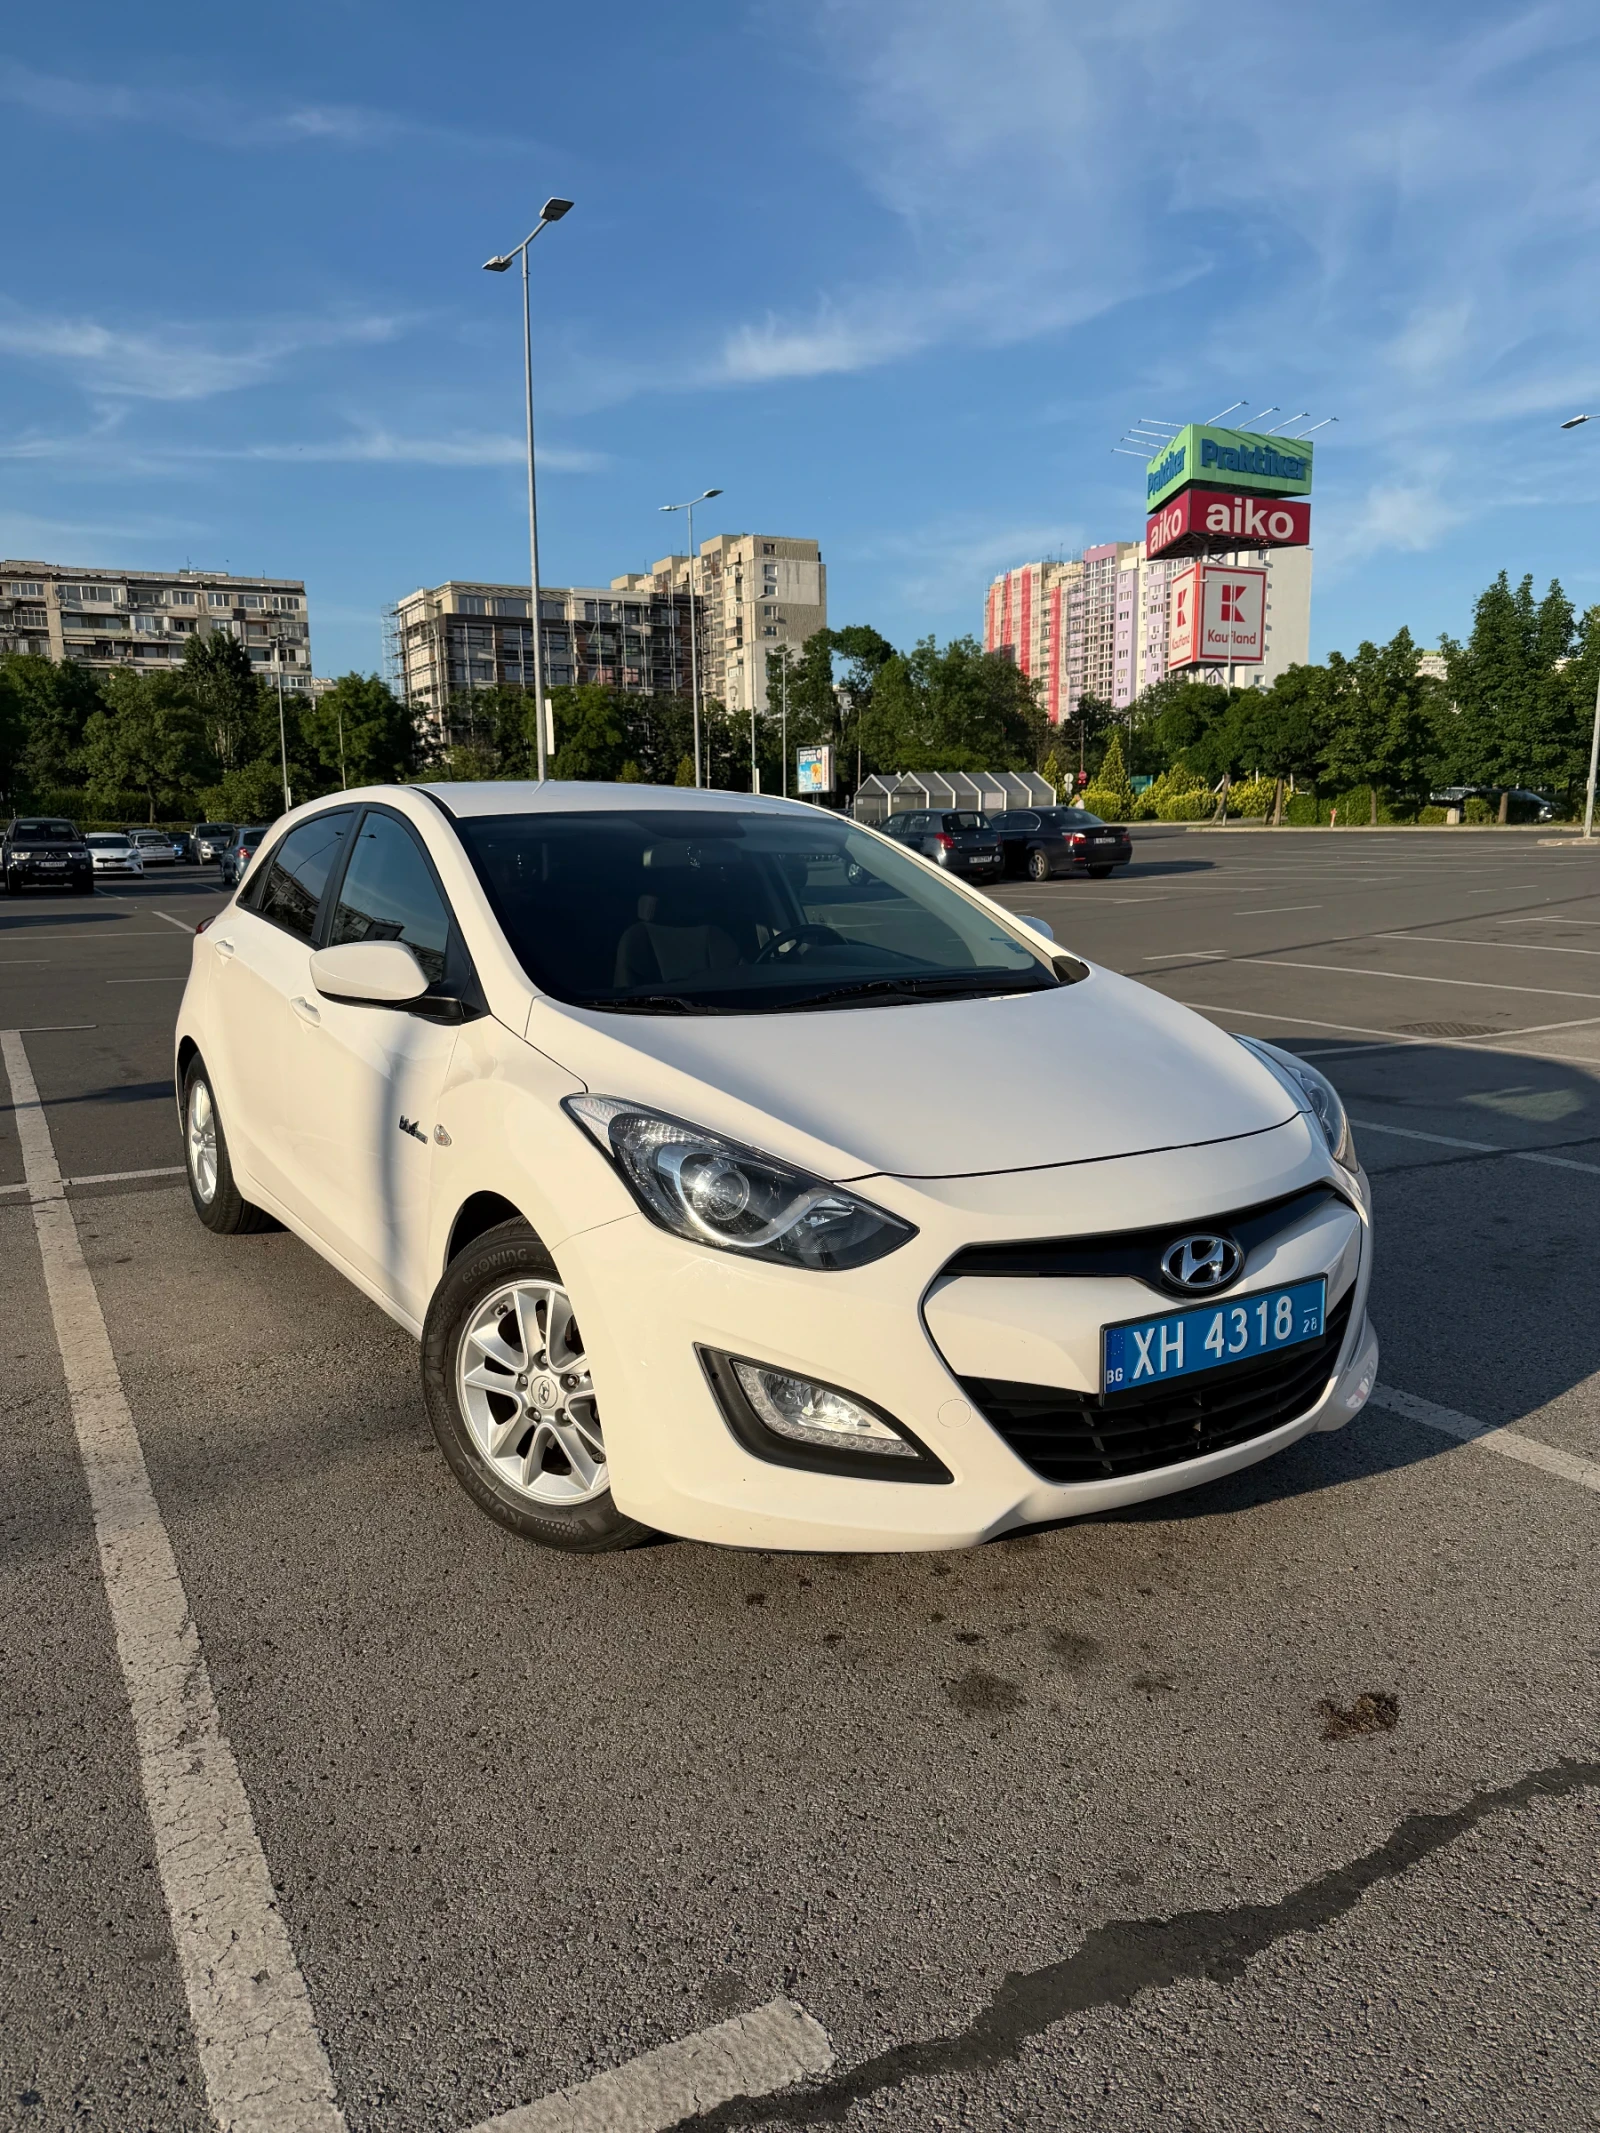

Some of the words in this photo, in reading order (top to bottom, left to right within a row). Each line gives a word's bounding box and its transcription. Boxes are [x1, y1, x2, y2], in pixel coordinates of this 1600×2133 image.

[1147, 445, 1186, 500] Praktiker
[1201, 438, 1306, 482] Praktiker
[1150, 508, 1182, 554] aiko
[1206, 498, 1294, 539] aiko
[1132, 1321, 1184, 1380] XH
[1204, 1295, 1293, 1359] 4318
[1302, 1316, 1318, 1333] 28
[1106, 1367, 1124, 1385] BG
